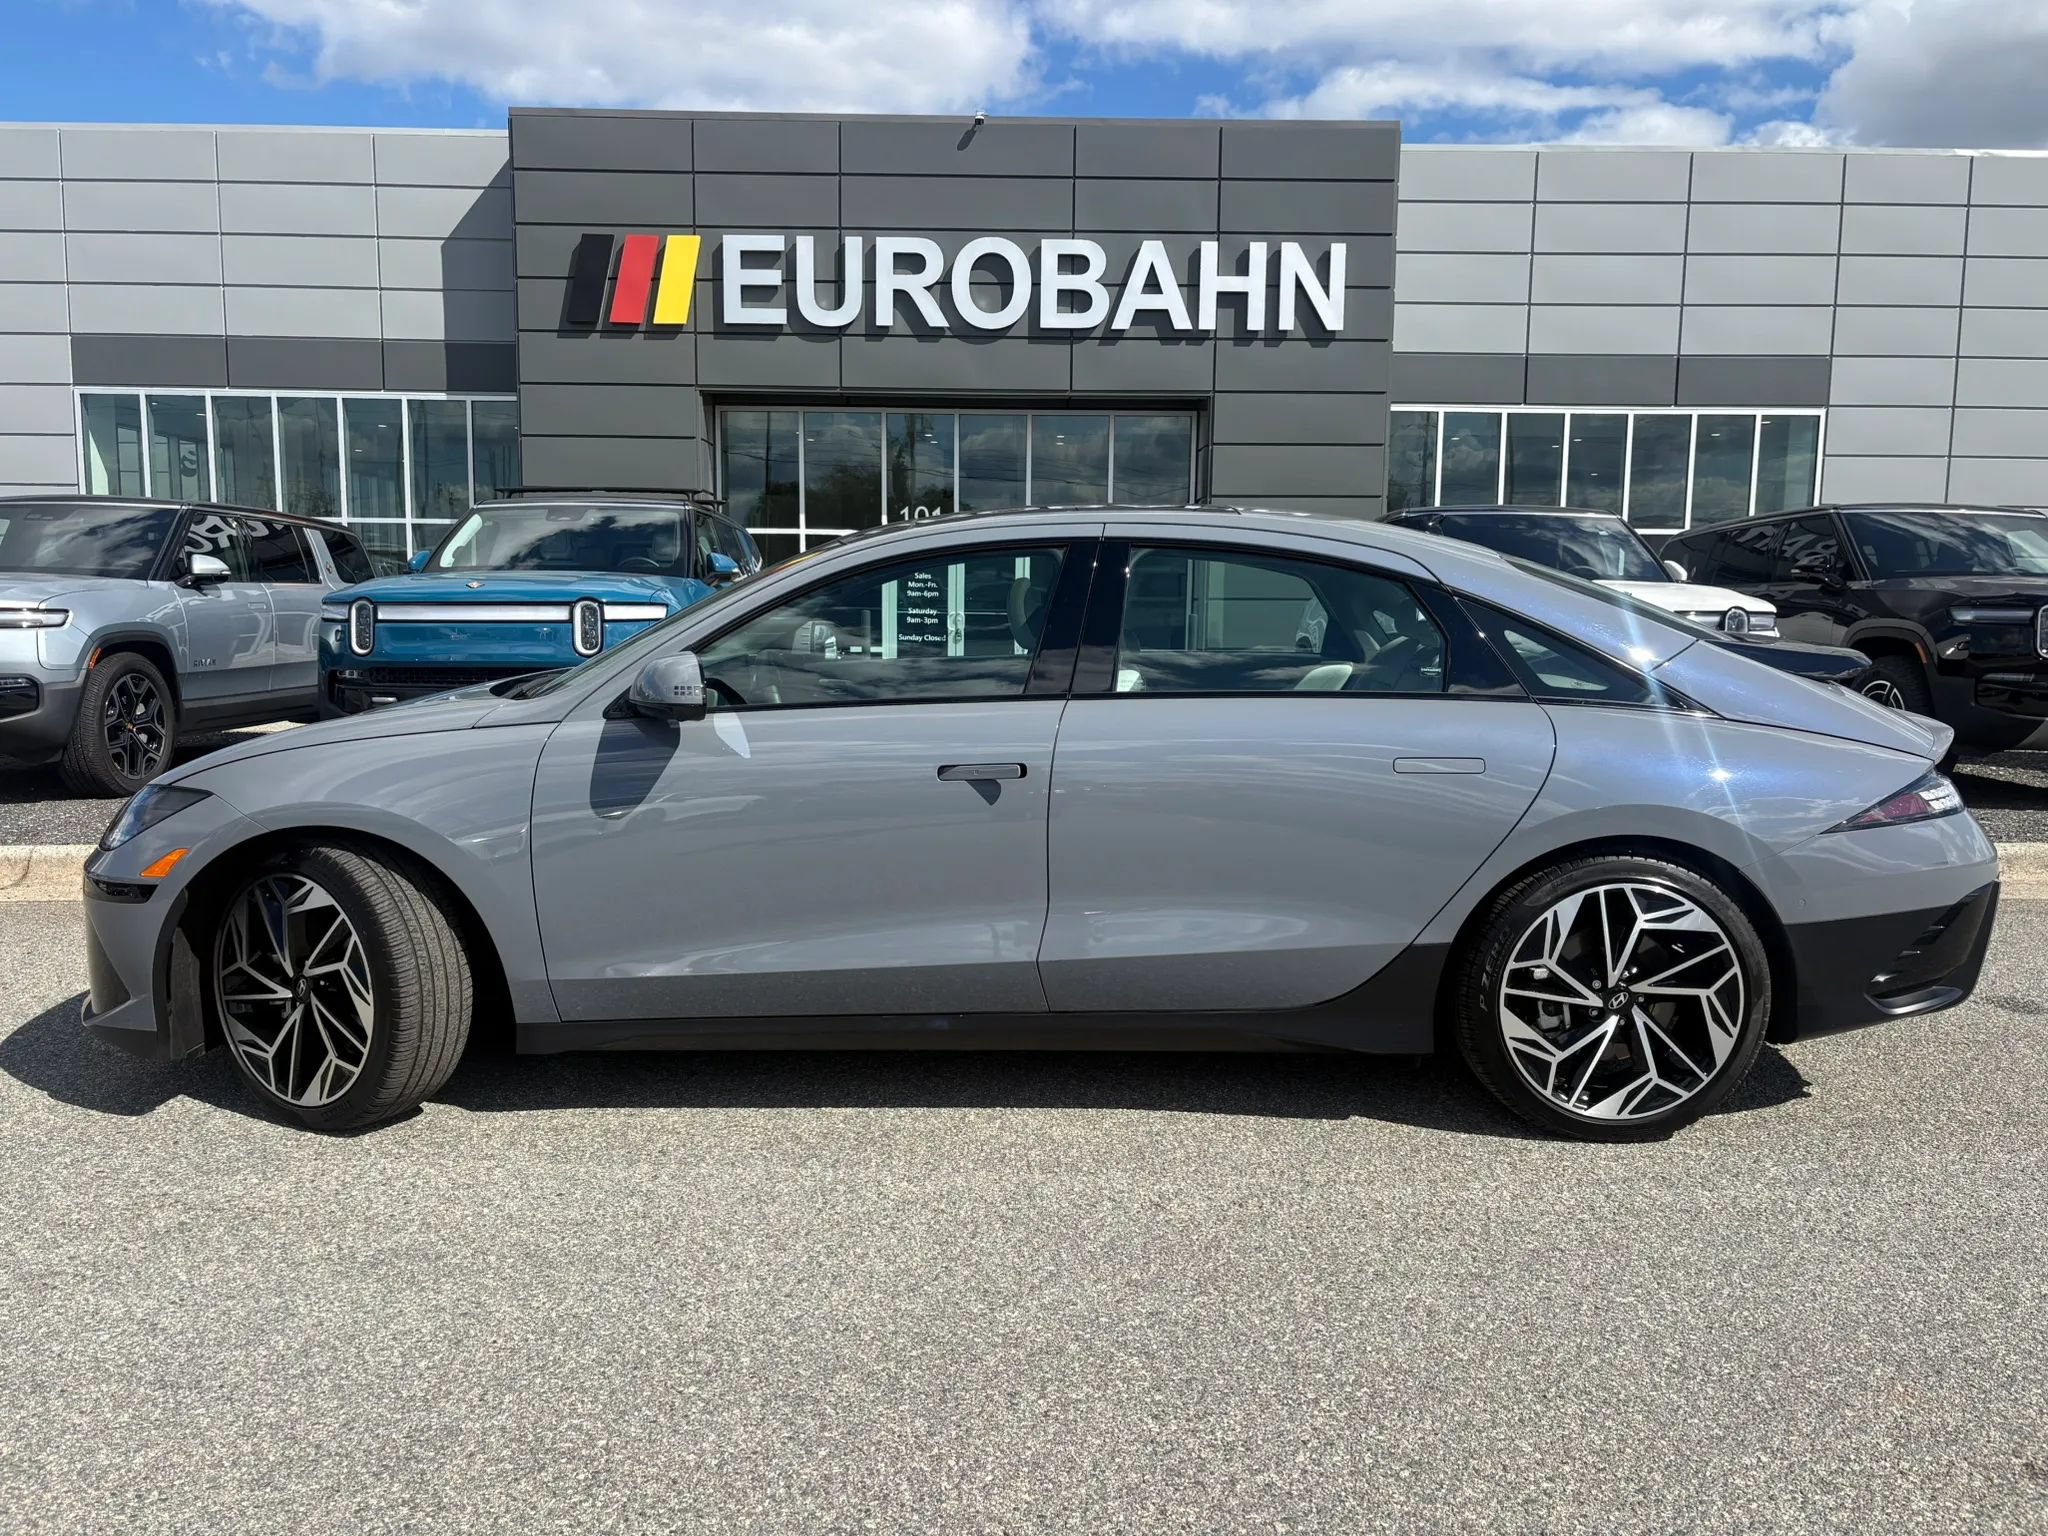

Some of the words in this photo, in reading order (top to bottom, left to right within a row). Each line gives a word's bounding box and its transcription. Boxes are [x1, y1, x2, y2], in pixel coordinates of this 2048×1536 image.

[722, 235, 1346, 331] EUROBAHN
[914, 572, 932, 580] Sales
[906, 590, 939, 598] 9am-6pm
[908, 607, 937, 616] Saturday
[906, 616, 939, 624] 9am-3pm
[898, 634, 923, 642] Sunday
